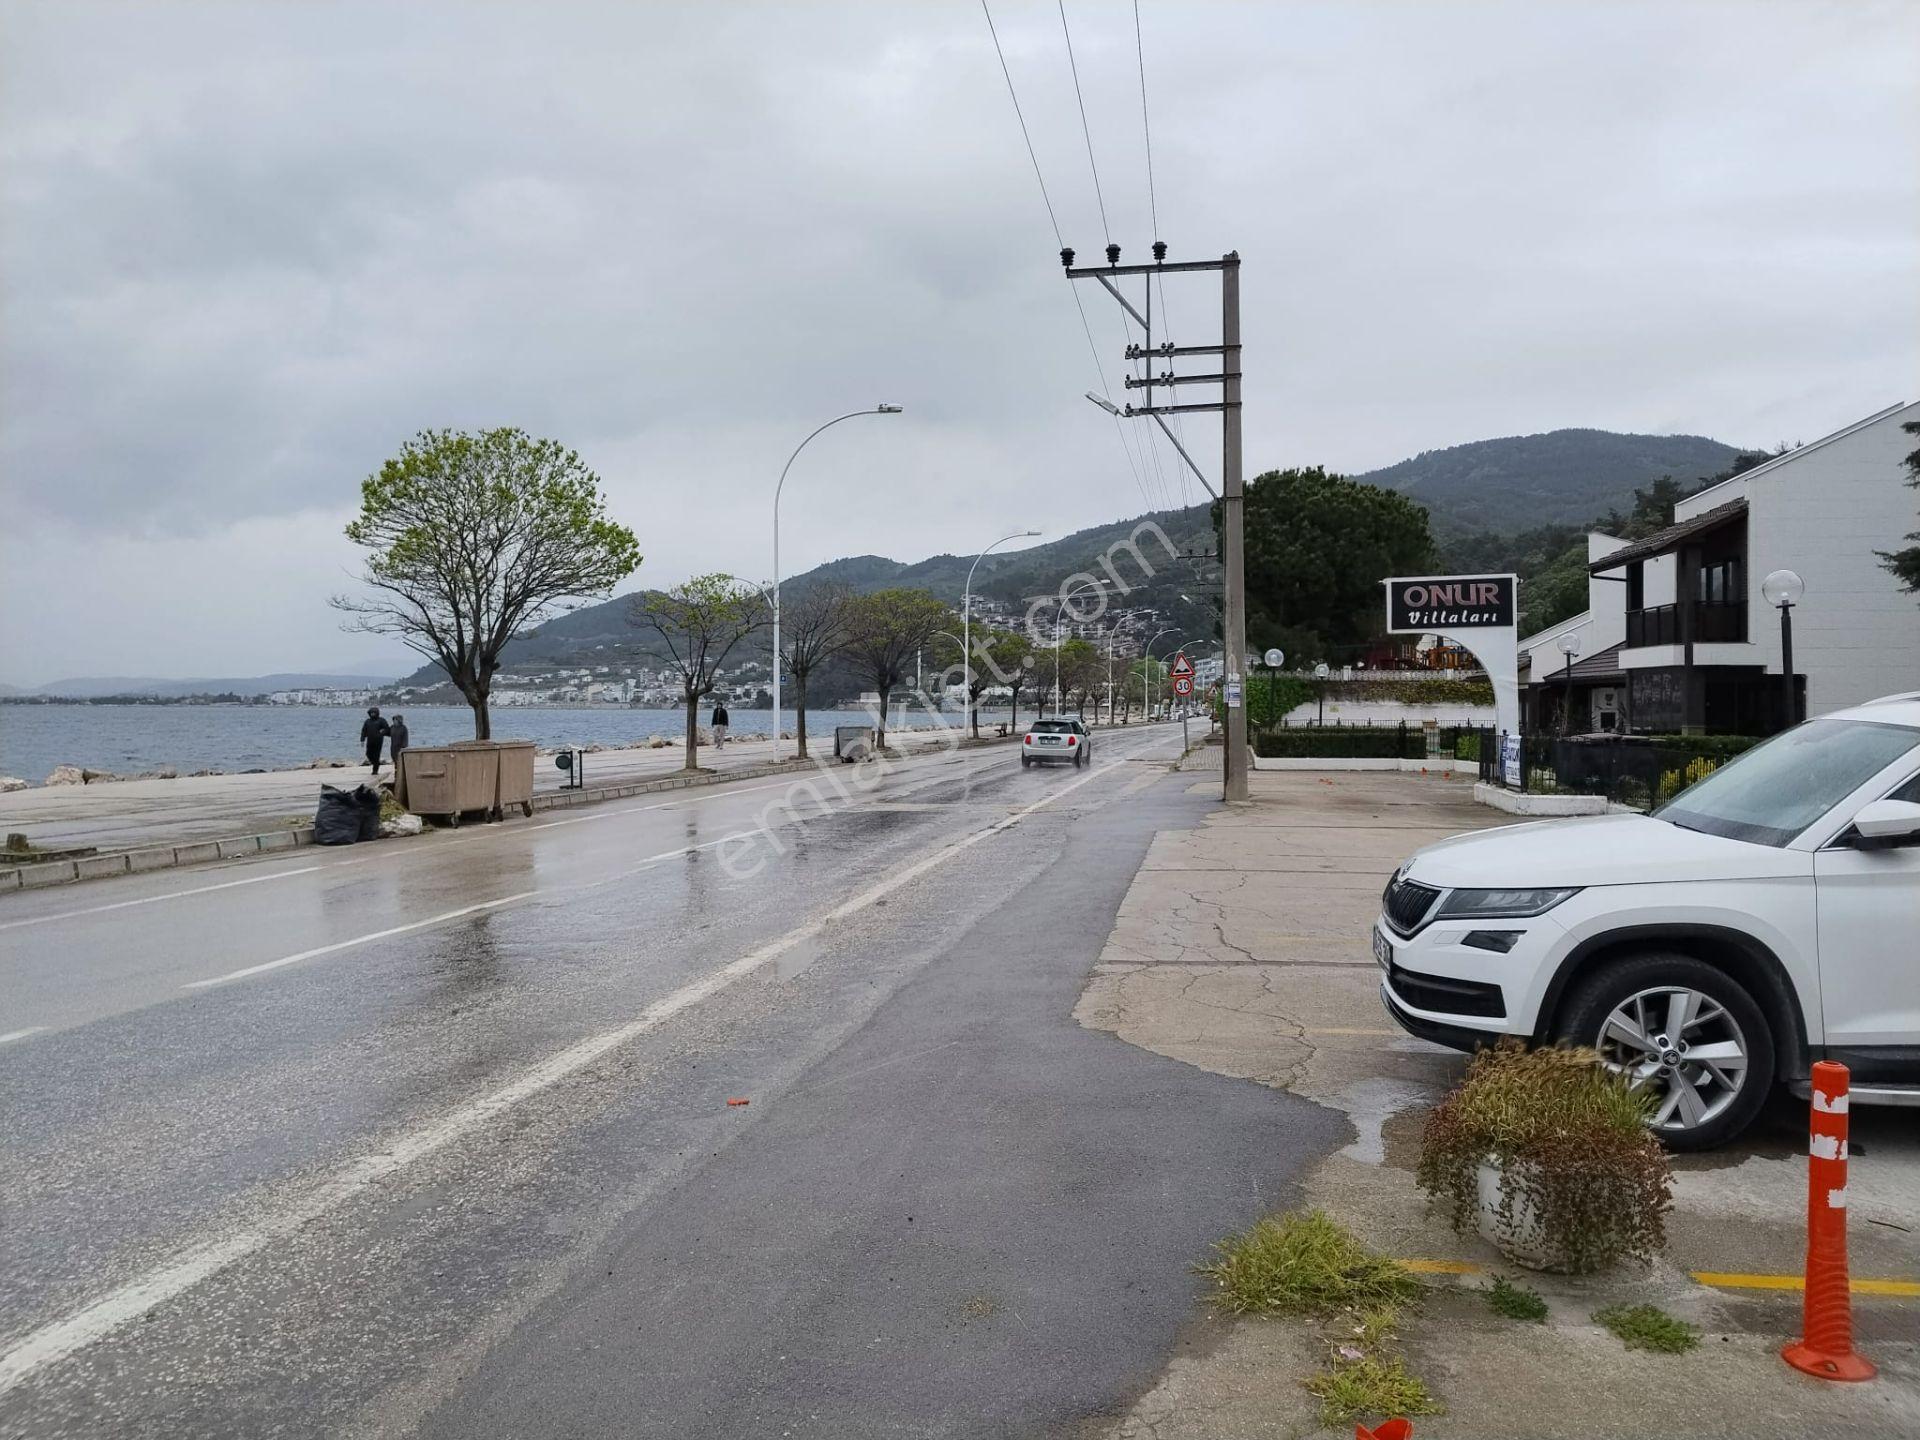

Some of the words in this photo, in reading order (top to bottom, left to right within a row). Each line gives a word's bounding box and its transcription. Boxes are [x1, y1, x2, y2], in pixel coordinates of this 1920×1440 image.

[1403, 583, 1500, 607] ONUR
[1408, 609, 1498, 625] Villaları
[1177, 681, 1190, 691] 30
